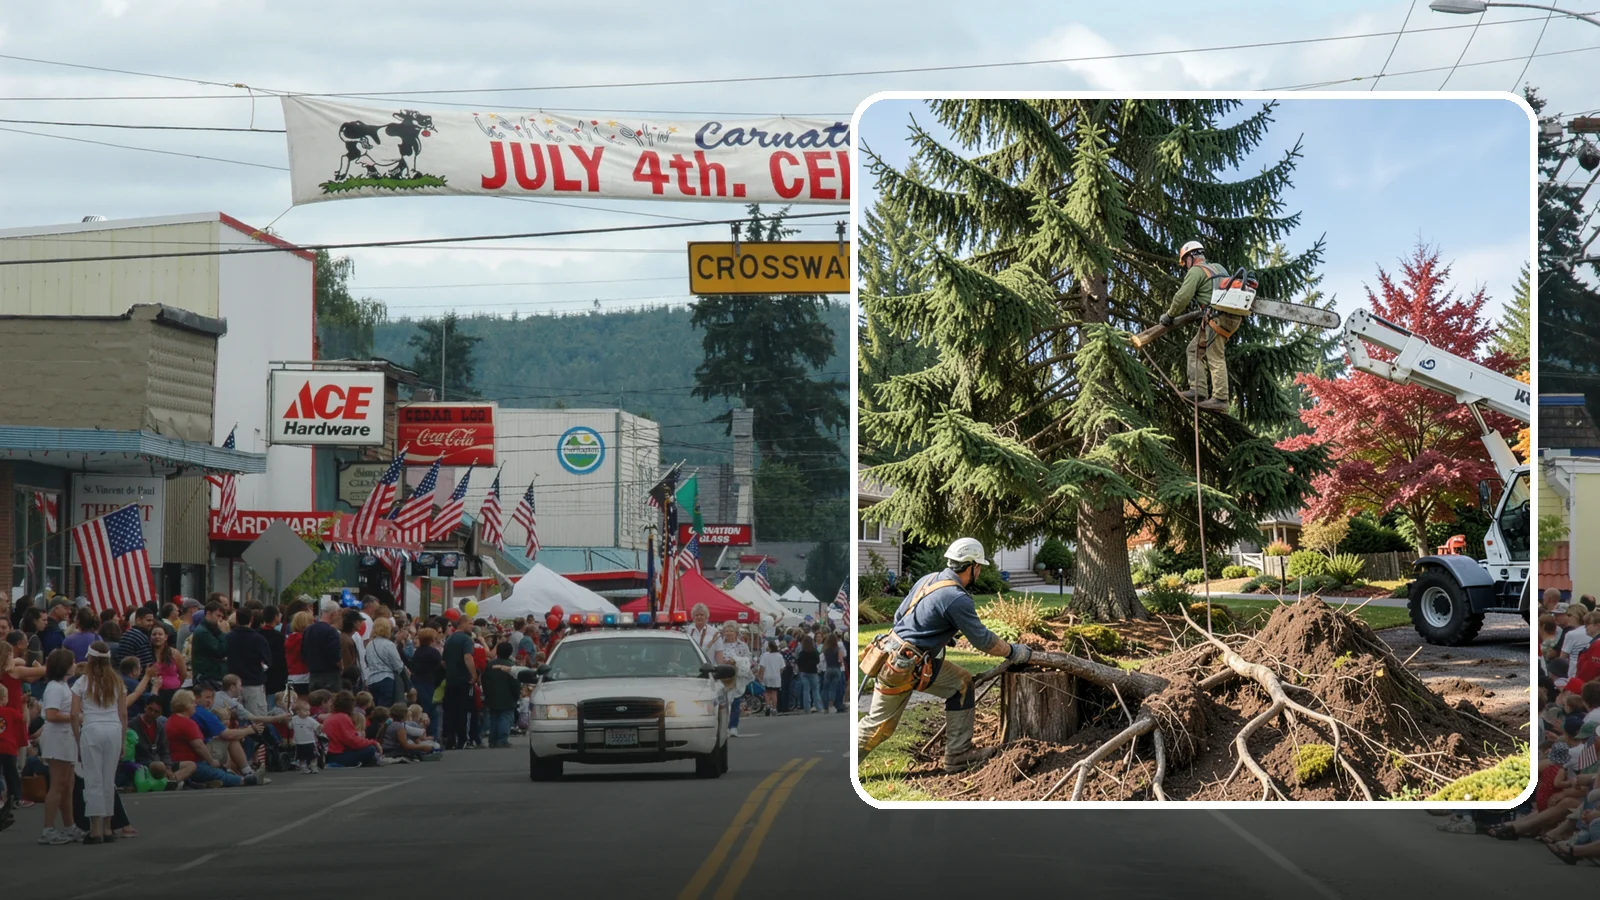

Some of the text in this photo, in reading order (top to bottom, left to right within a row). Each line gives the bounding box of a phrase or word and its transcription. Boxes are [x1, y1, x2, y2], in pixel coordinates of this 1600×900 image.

[481, 141, 605, 192] JULY
[632, 150, 747, 198] 4th.
[697, 254, 850, 280] CROSSWA
[282, 380, 374, 420] ACE
[406, 409, 452, 422] CEDAR
[283, 421, 371, 436] Hardware
[353, 467, 386, 481] Simpl
[95, 485, 124, 494] Vincent
[126, 486, 136, 494] de
[137, 486, 155, 495] Paul
[213, 516, 331, 535] HARDARE
[688, 526, 741, 535] CRNATION
[699, 535, 730, 543] GLASS
